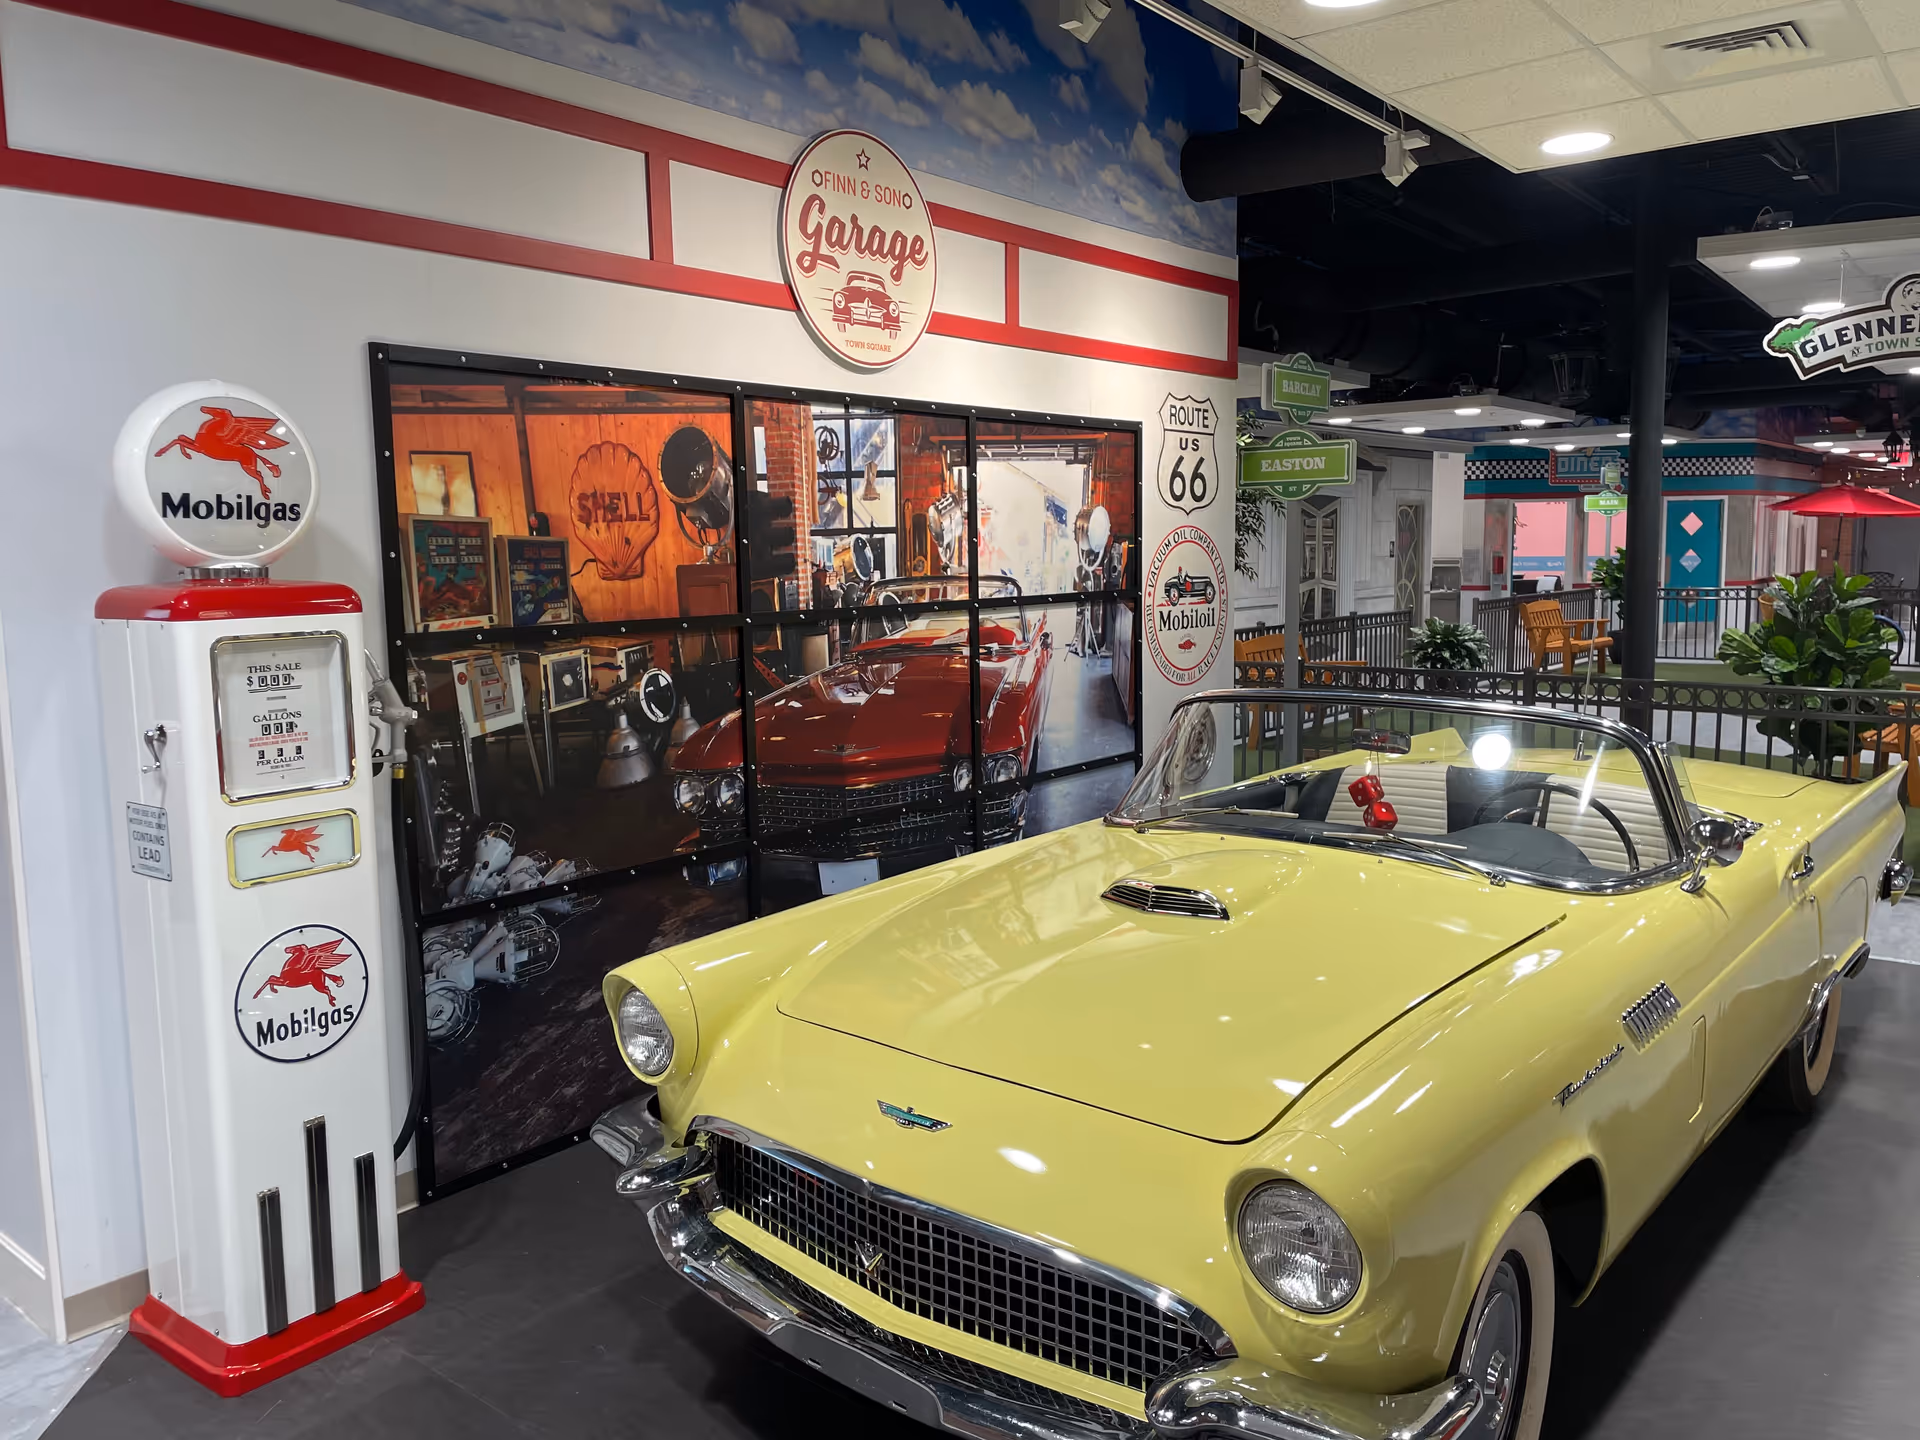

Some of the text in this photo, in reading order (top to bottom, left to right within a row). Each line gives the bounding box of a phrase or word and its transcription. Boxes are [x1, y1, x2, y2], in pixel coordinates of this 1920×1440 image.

[824, 171, 902, 208] FINN & SON
[796, 193, 929, 286] Garage
[845, 339, 892, 353] TOWN SQUARE
[1799, 313, 1920, 359] GLENNE
[1865, 337, 1909, 354] TOWN
[1282, 379, 1321, 397] BARCLAY
[1169, 404, 1209, 429] ROUTE
[1179, 437, 1200, 452] US
[1260, 456, 1327, 472] EASTON
[1169, 454, 1207, 503] 66
[161, 492, 301, 529] Mobilgas
[576, 490, 651, 523] SHELL
[1148, 528, 1226, 588] VACUUM OIL COMPANY LTD
[1158, 607, 1216, 632] Mobiloil
[1146, 603, 1172, 677] RECOMMENDED
[1172, 669, 1186, 682] FOR
[1187, 669, 1197, 682] ALL
[246, 662, 302, 674] THIS SALE
[252, 710, 302, 723] GALLONS
[256, 758, 272, 767] PER
[273, 754, 305, 766] GALLON
[132, 830, 165, 847] CONTAINS
[137, 846, 161, 863] LEAD
[256, 1004, 355, 1047] Mobilgas
